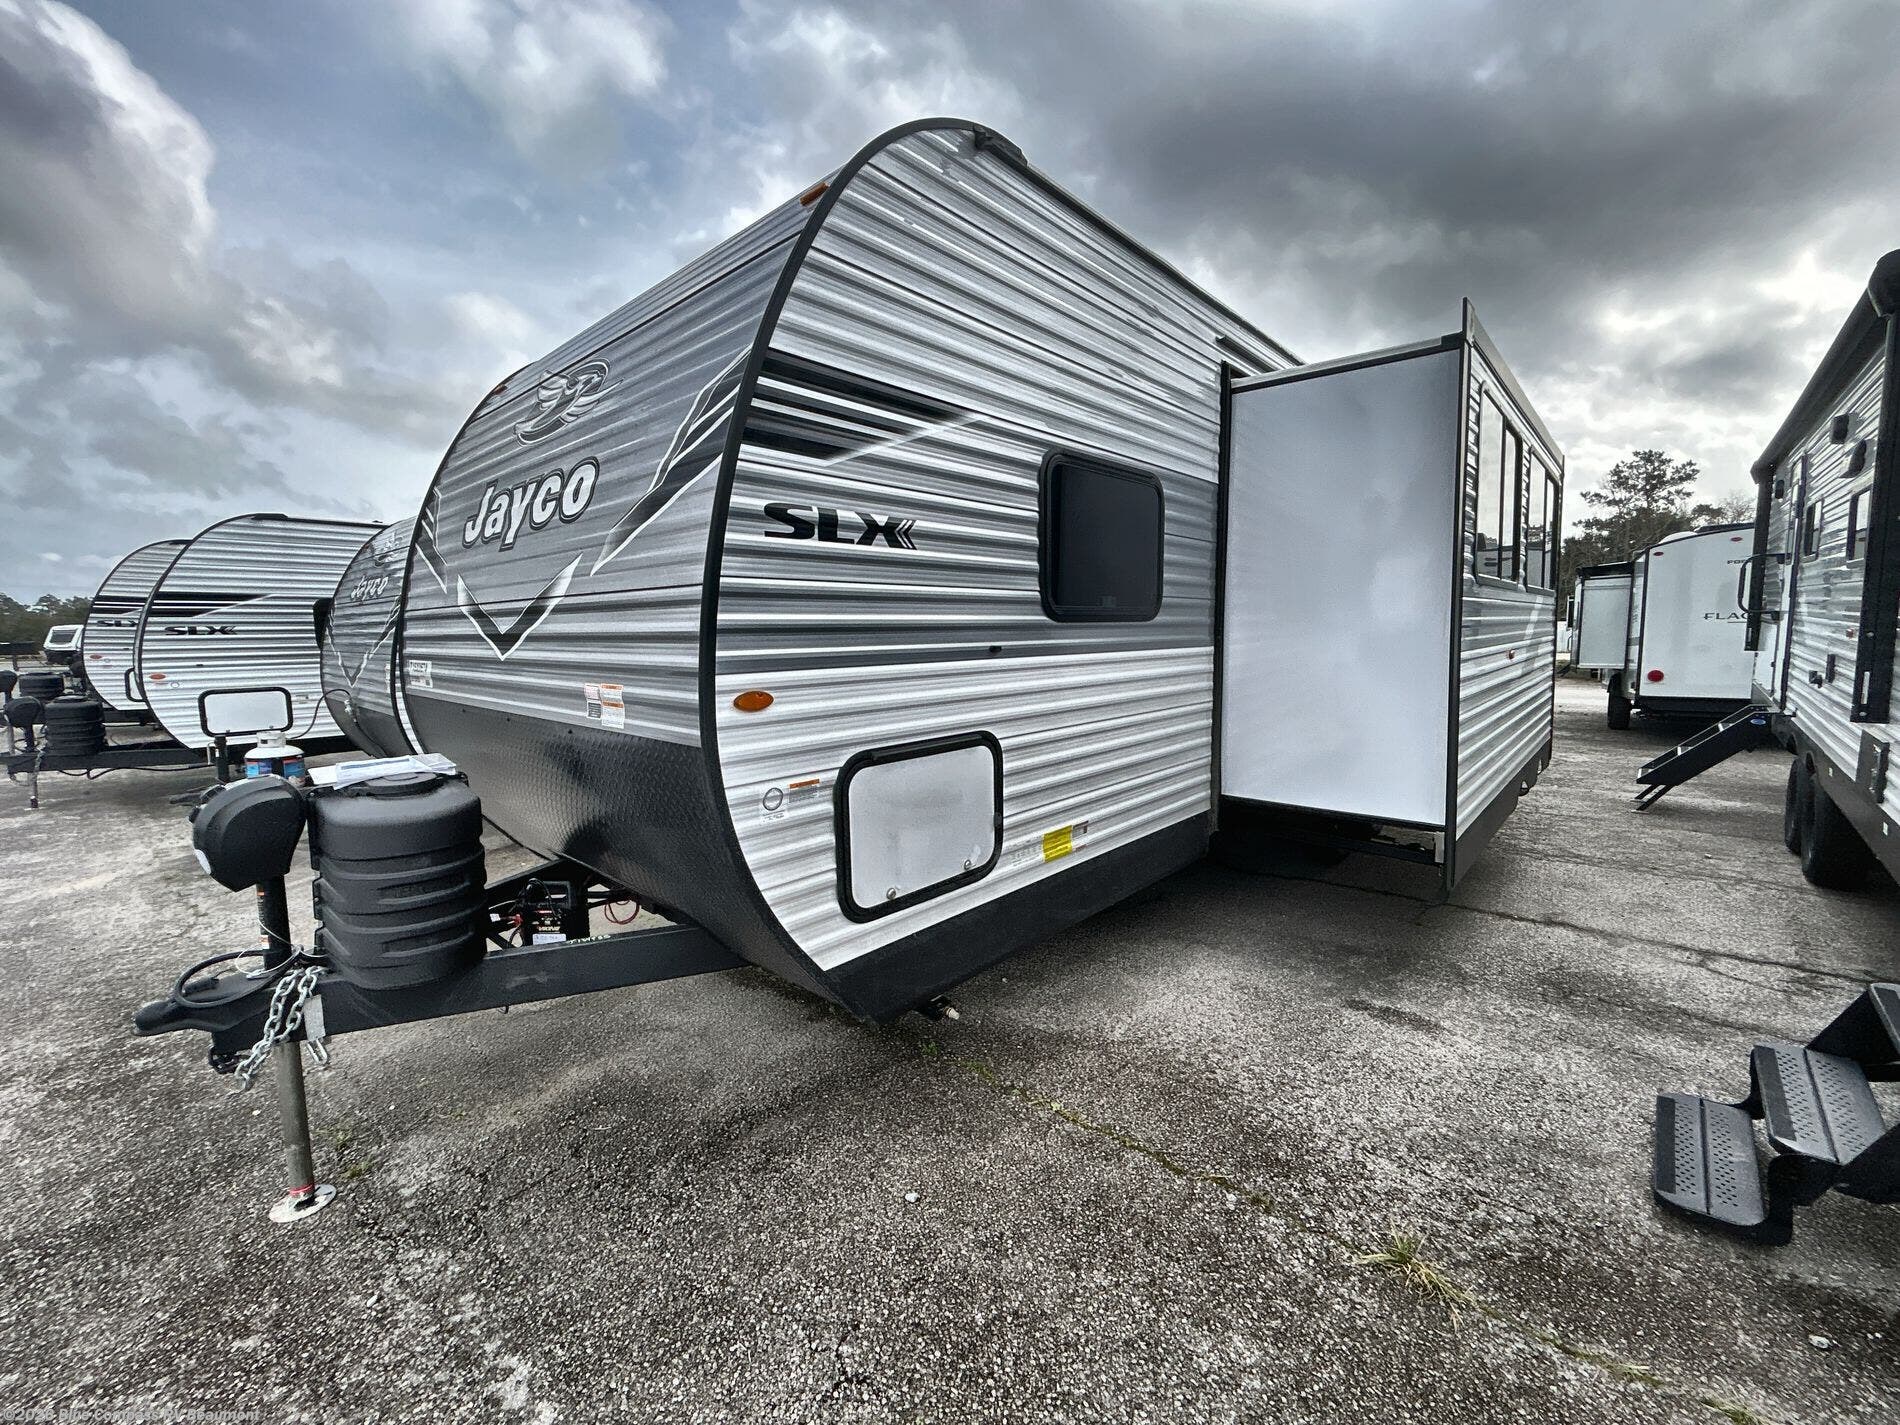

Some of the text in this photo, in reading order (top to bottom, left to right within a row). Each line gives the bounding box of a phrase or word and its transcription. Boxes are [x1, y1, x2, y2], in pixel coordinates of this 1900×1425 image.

[463, 456, 600, 551] Jayco
[764, 502, 912, 549] SLX
[351, 574, 389, 602] Jayco
[164, 625, 234, 636] SLX
